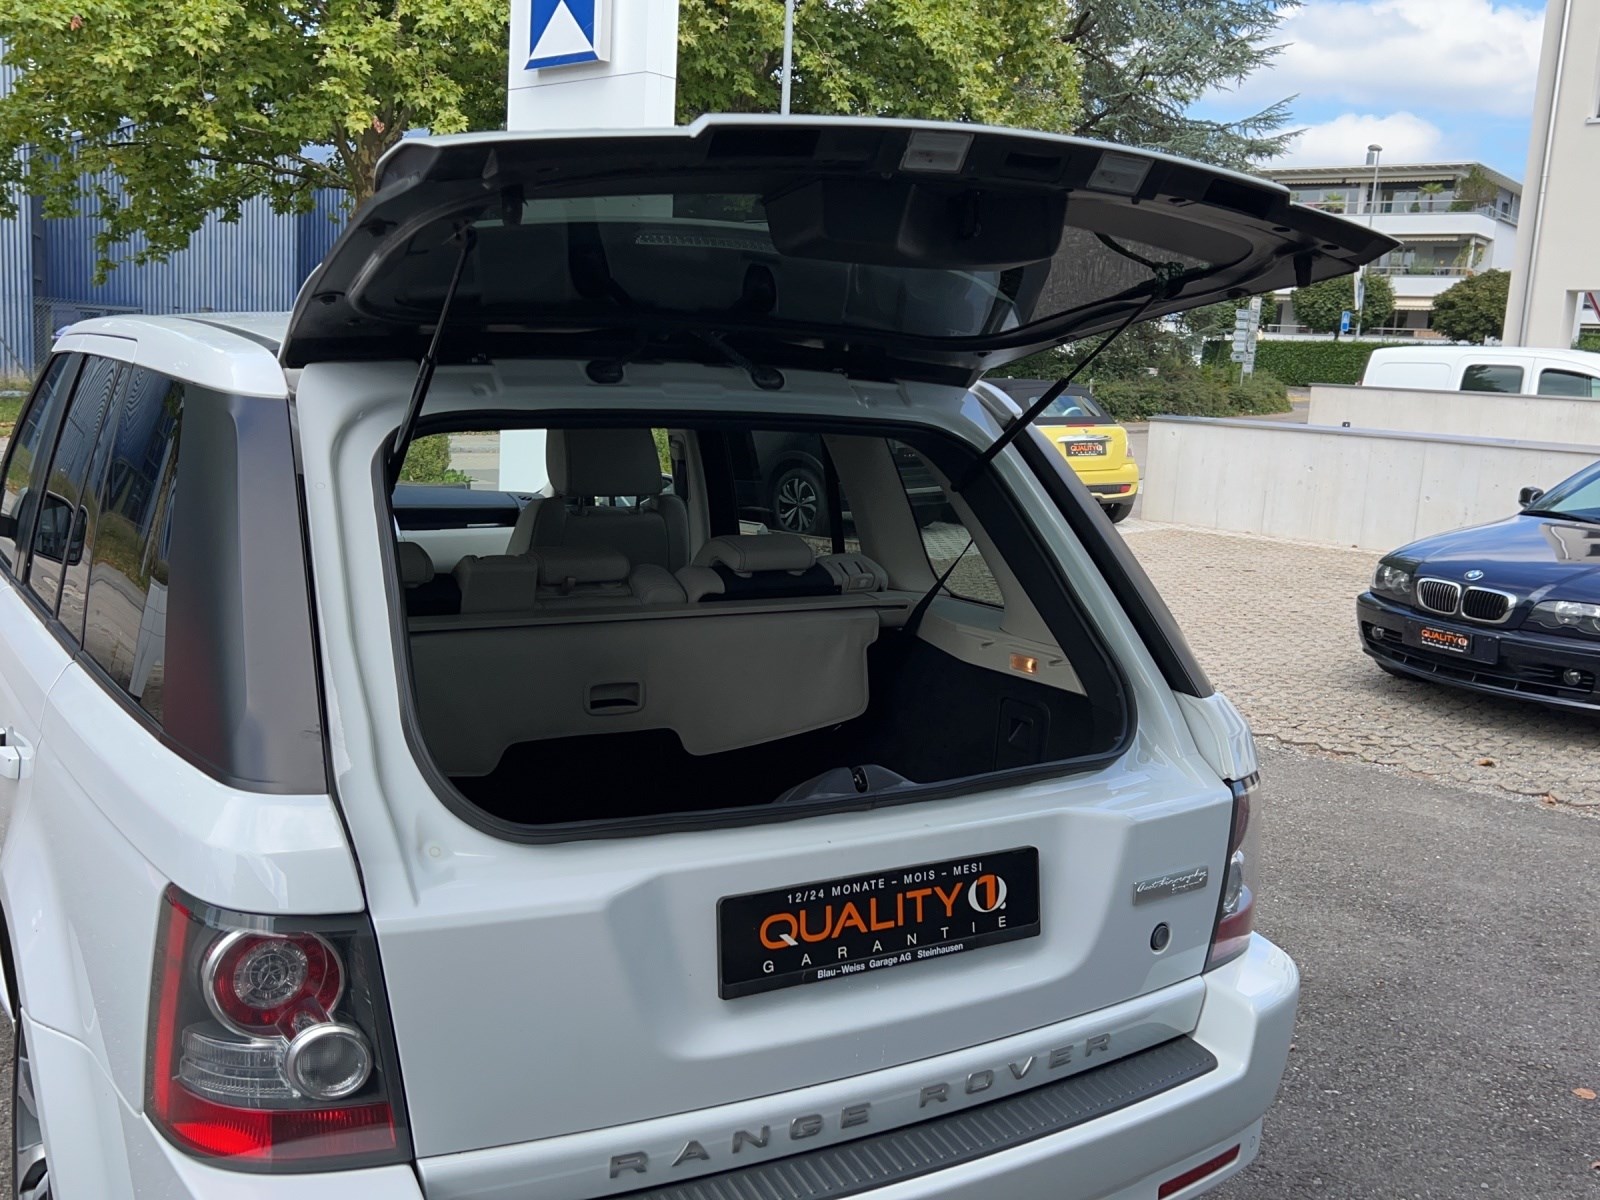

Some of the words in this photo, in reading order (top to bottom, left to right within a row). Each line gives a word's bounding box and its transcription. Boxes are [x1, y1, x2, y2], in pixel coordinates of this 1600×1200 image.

[1421, 629, 1458, 643] QUALITY
[787, 888, 824, 904] 12/24
[831, 878, 885, 897] MONATE
[904, 870, 935, 885] MOIS
[953, 862, 982, 876] MESI
[759, 881, 964, 950] QUALITY
[817, 963, 865, 979] Blau-Weiss
[869, 954, 898, 970] Garage
[899, 951, 912, 963] AG
[917, 942, 964, 959] Steinhausen
[608, 1102, 871, 1179] RANGE
[919, 1033, 1111, 1108] ROVER
